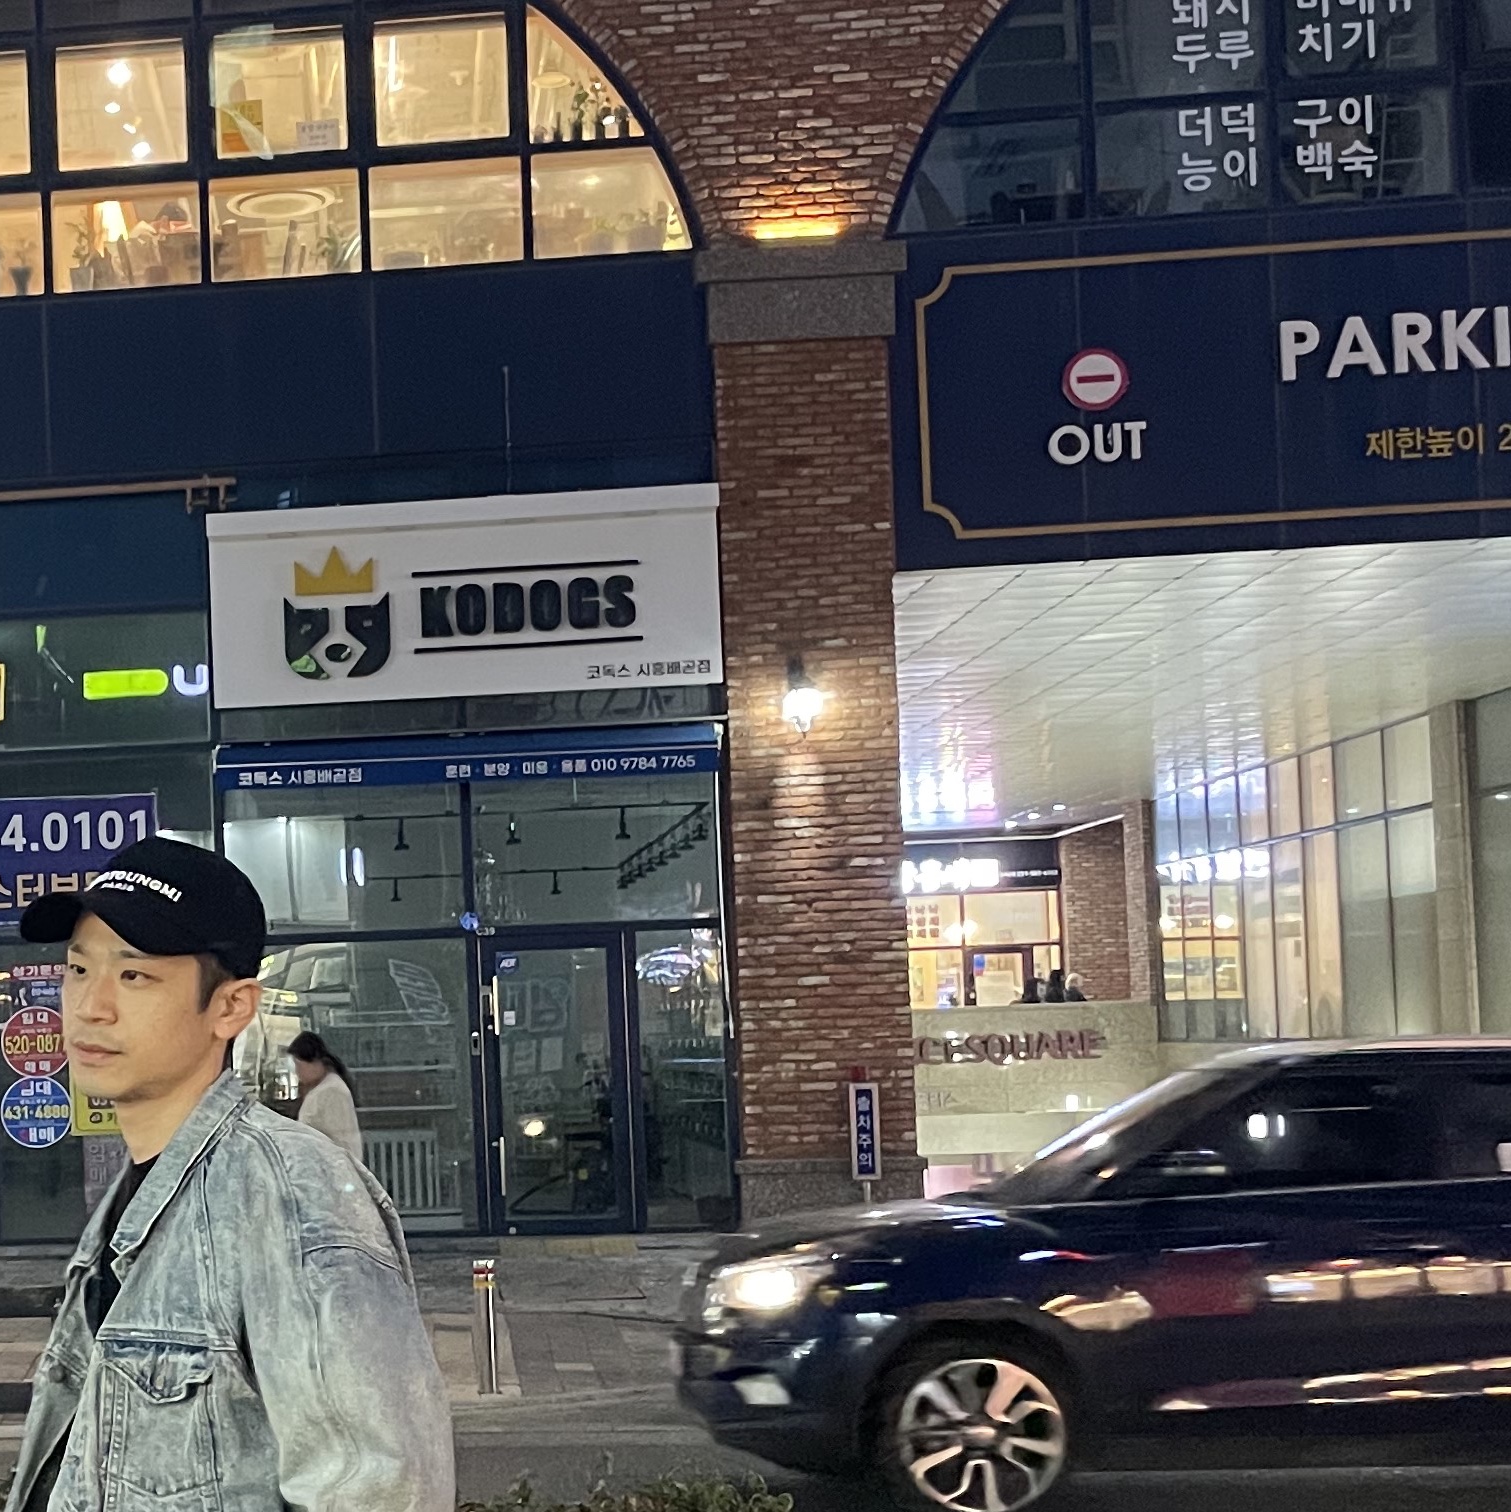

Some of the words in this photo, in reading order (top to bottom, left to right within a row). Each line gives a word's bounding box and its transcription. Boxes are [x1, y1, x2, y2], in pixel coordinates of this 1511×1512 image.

[1172, 30, 1254, 74] 두루
[1298, 19, 1376, 62] 치기
[1178, 102, 1255, 146] 더덕
[1293, 94, 1373, 138] 구이
[1177, 146, 1257, 192] 능이
[1296, 139, 1378, 181] 백숙
[1279, 306, 1511, 382] PARKI
[1048, 421, 1147, 465] OUT
[1365, 423, 1484, 460] 제한높이
[420, 575, 636, 638] KODOGS
[587, 664, 632, 679] 코독스
[238, 771, 283, 785] 코독스
[591, 758, 617, 772] 010
[620, 756, 657, 771] 9784
[660, 754, 696, 769] 7765
[5, 1033, 65, 1055] 520-087
